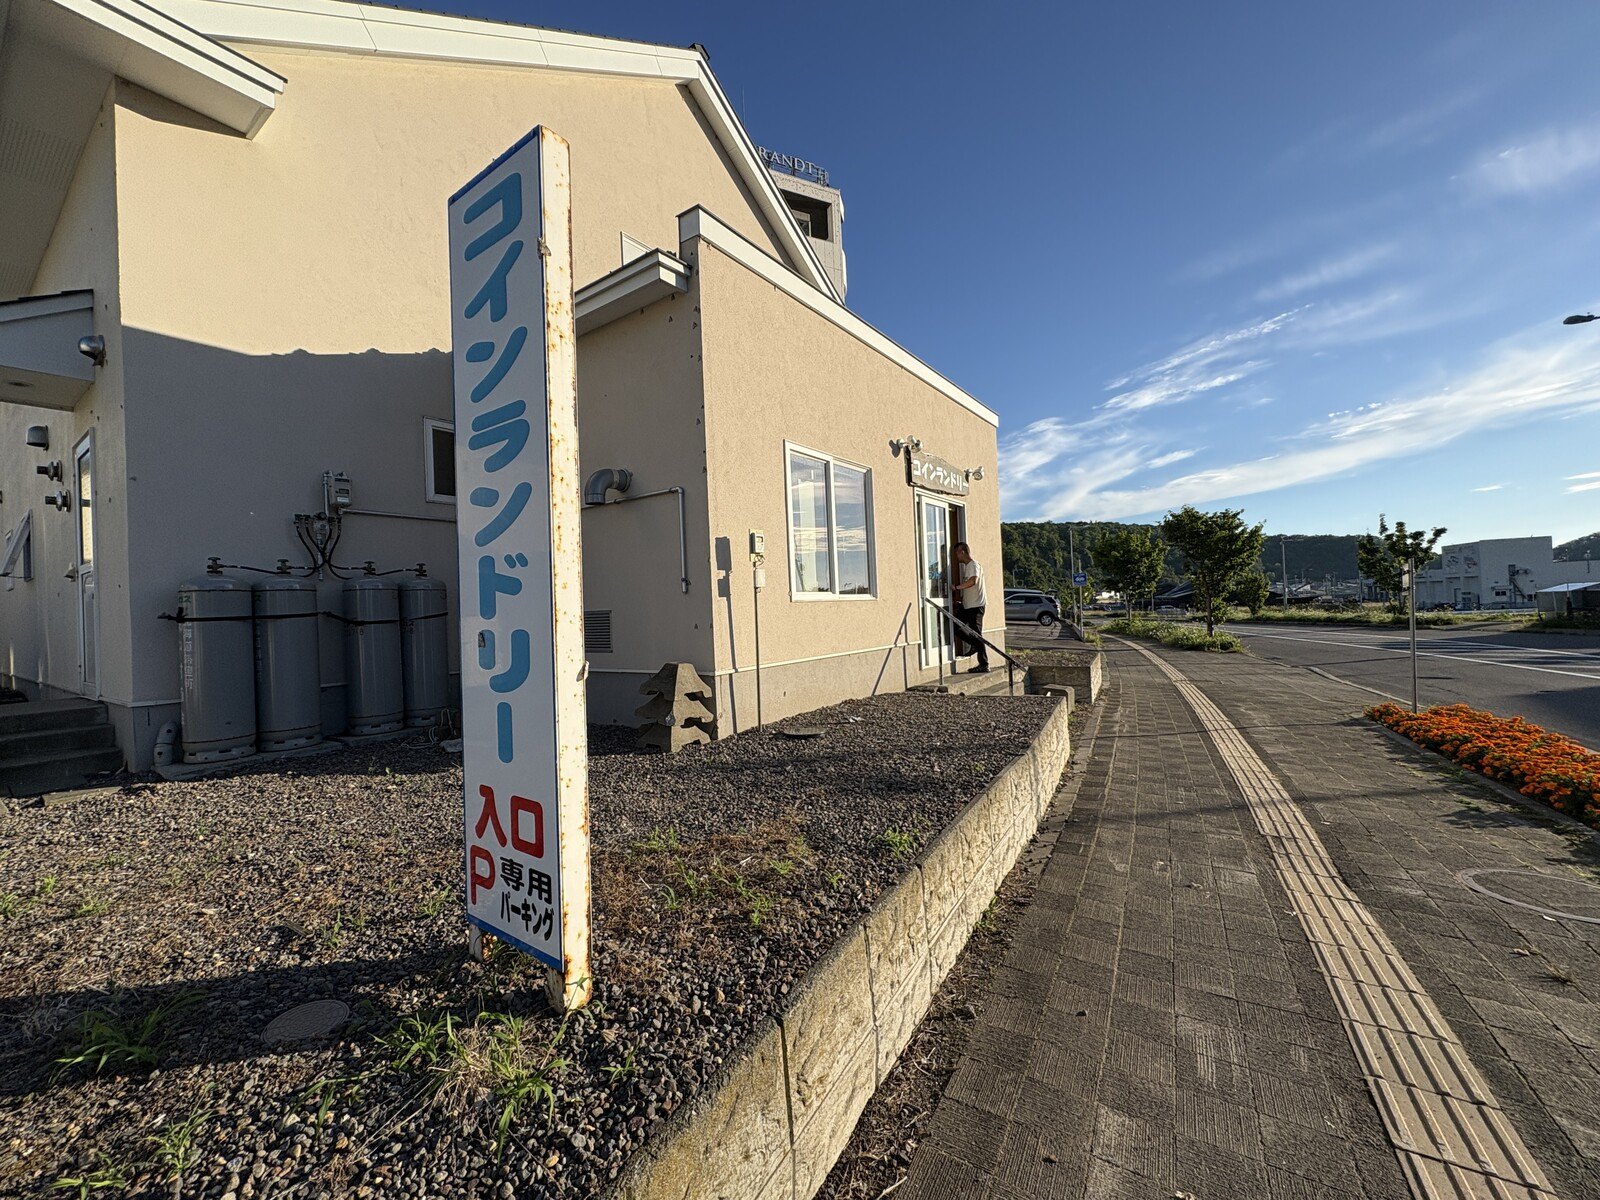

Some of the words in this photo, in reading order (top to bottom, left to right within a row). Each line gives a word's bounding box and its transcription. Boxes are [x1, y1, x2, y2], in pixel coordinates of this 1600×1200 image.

[463, 172, 532, 764] コインランドリー
[912, 459, 969, 491] コインランドリー
[475, 784, 545, 859] 入口
[470, 844, 496, 905] P
[500, 856, 553, 905] 専用
[501, 890, 555, 942] パーキング
